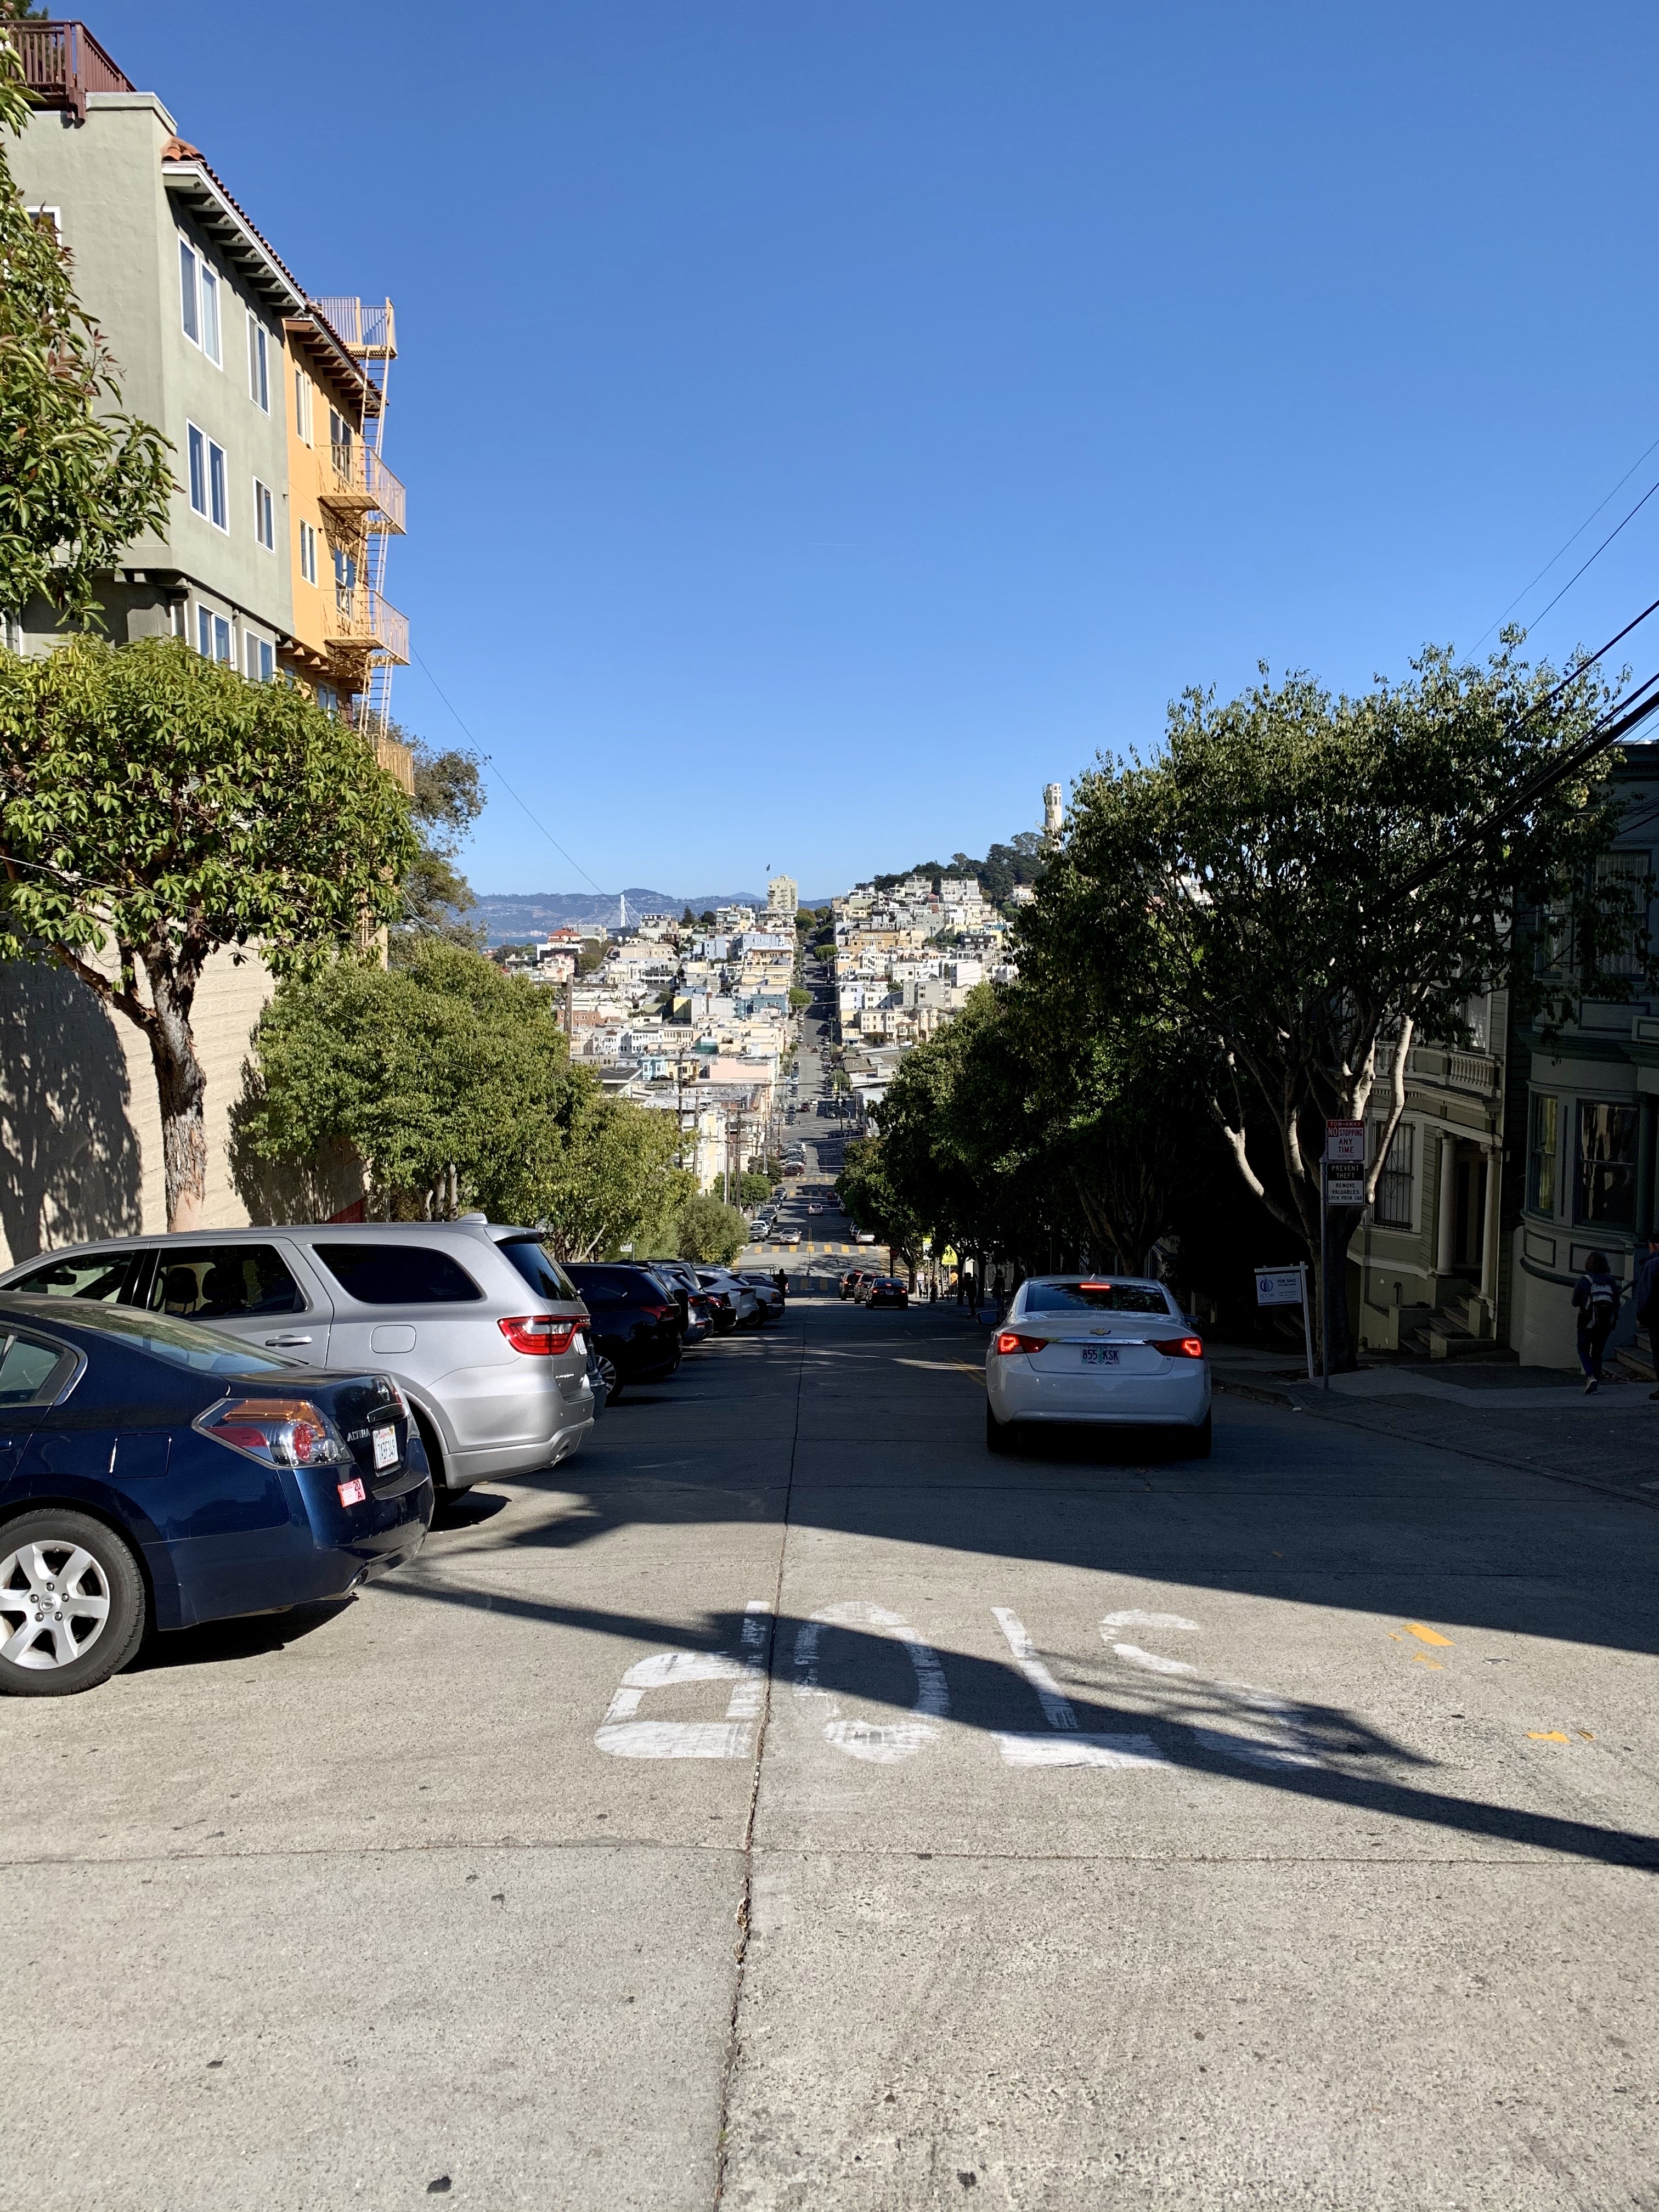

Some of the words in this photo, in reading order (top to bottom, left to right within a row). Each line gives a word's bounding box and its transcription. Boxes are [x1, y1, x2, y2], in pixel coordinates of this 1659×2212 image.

[1328, 1127, 1338, 1136] NO
[1082, 1349, 1098, 1360] 855
[1103, 1350, 1119, 1361] KSK
[353, 1480, 361, 1491] 20
[358, 1491, 363, 1500] A
